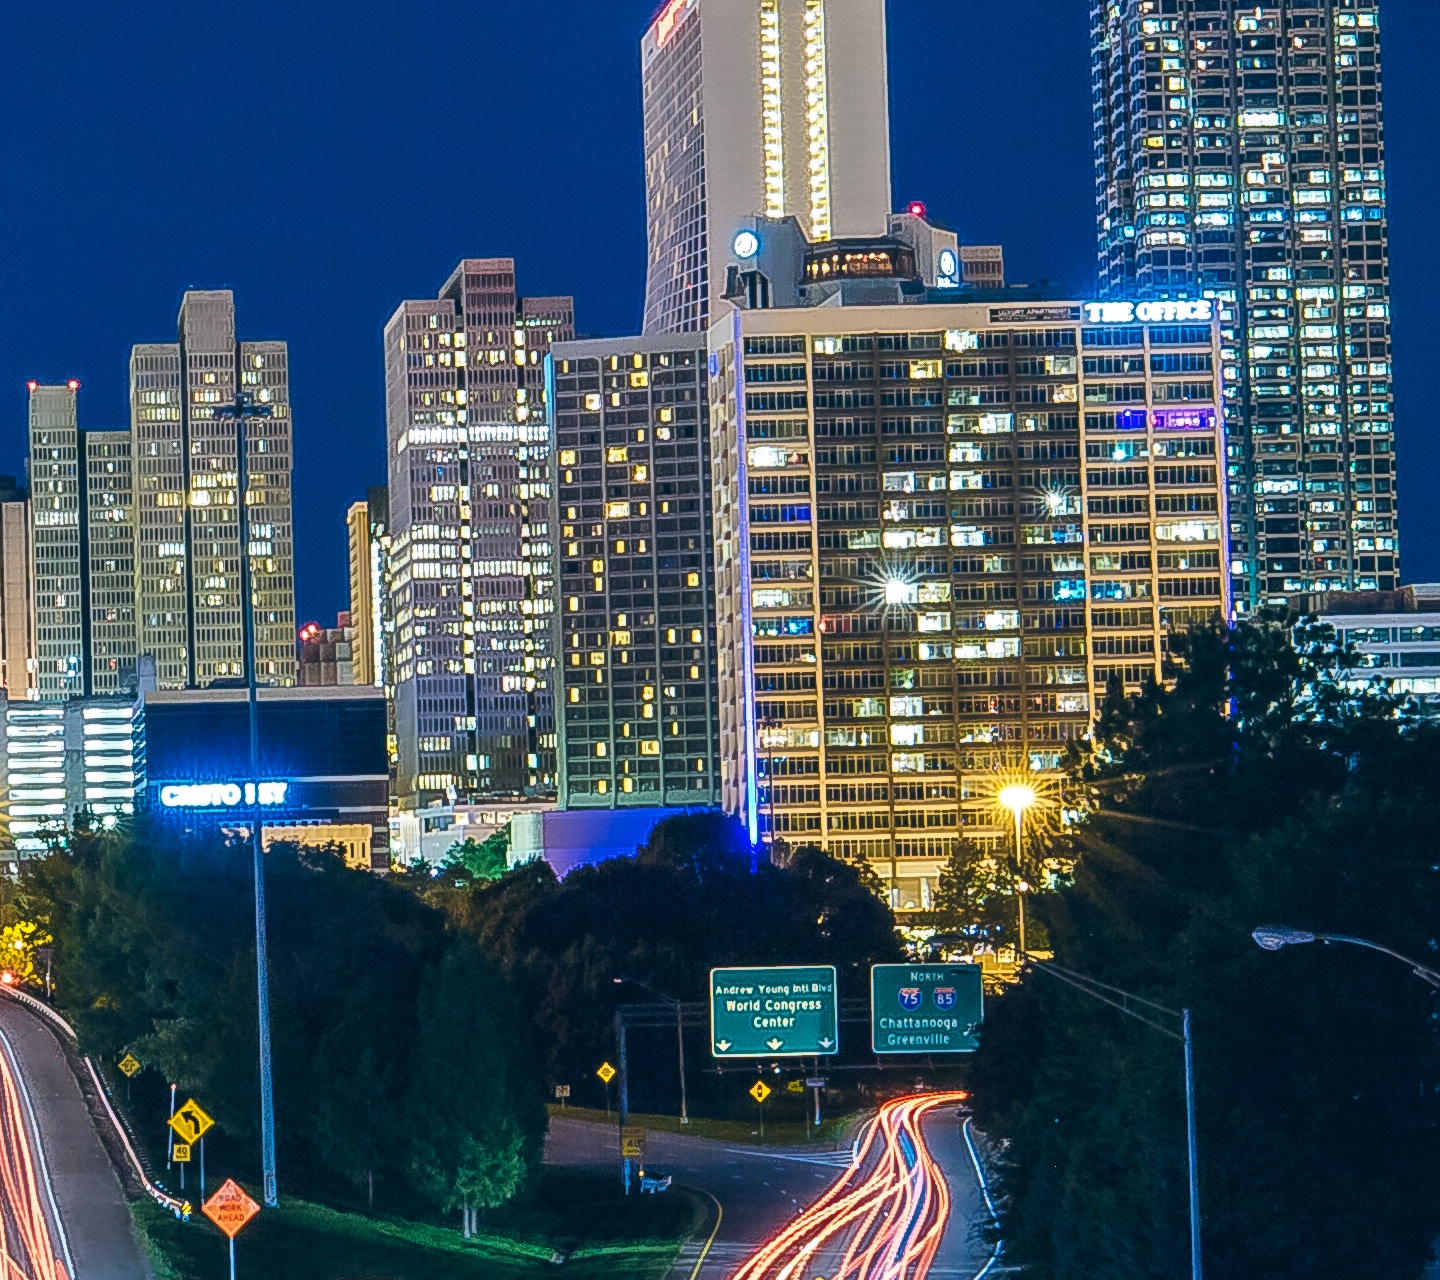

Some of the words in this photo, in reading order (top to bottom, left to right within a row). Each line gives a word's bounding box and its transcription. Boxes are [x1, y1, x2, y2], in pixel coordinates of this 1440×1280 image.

[1085, 302, 1134, 322] THE
[1136, 300, 1211, 321] OFFICE
[910, 971, 944, 982] NORTH
[715, 985, 754, 995] Andrew
[758, 984, 790, 996] Young
[811, 983, 832, 993] Blvd
[902, 993, 918, 1005] 75
[937, 993, 953, 1005] 85
[726, 1000, 760, 1012] World
[765, 999, 822, 1014] Congress
[753, 1016, 795, 1028] Center
[879, 1017, 958, 1031] Chattanooga
[887, 1033, 950, 1045] Greenville
[176, 1146, 188, 1155] 40
[219, 1204, 242, 1212] WORK
[217, 1213, 245, 1221] AHEAD
